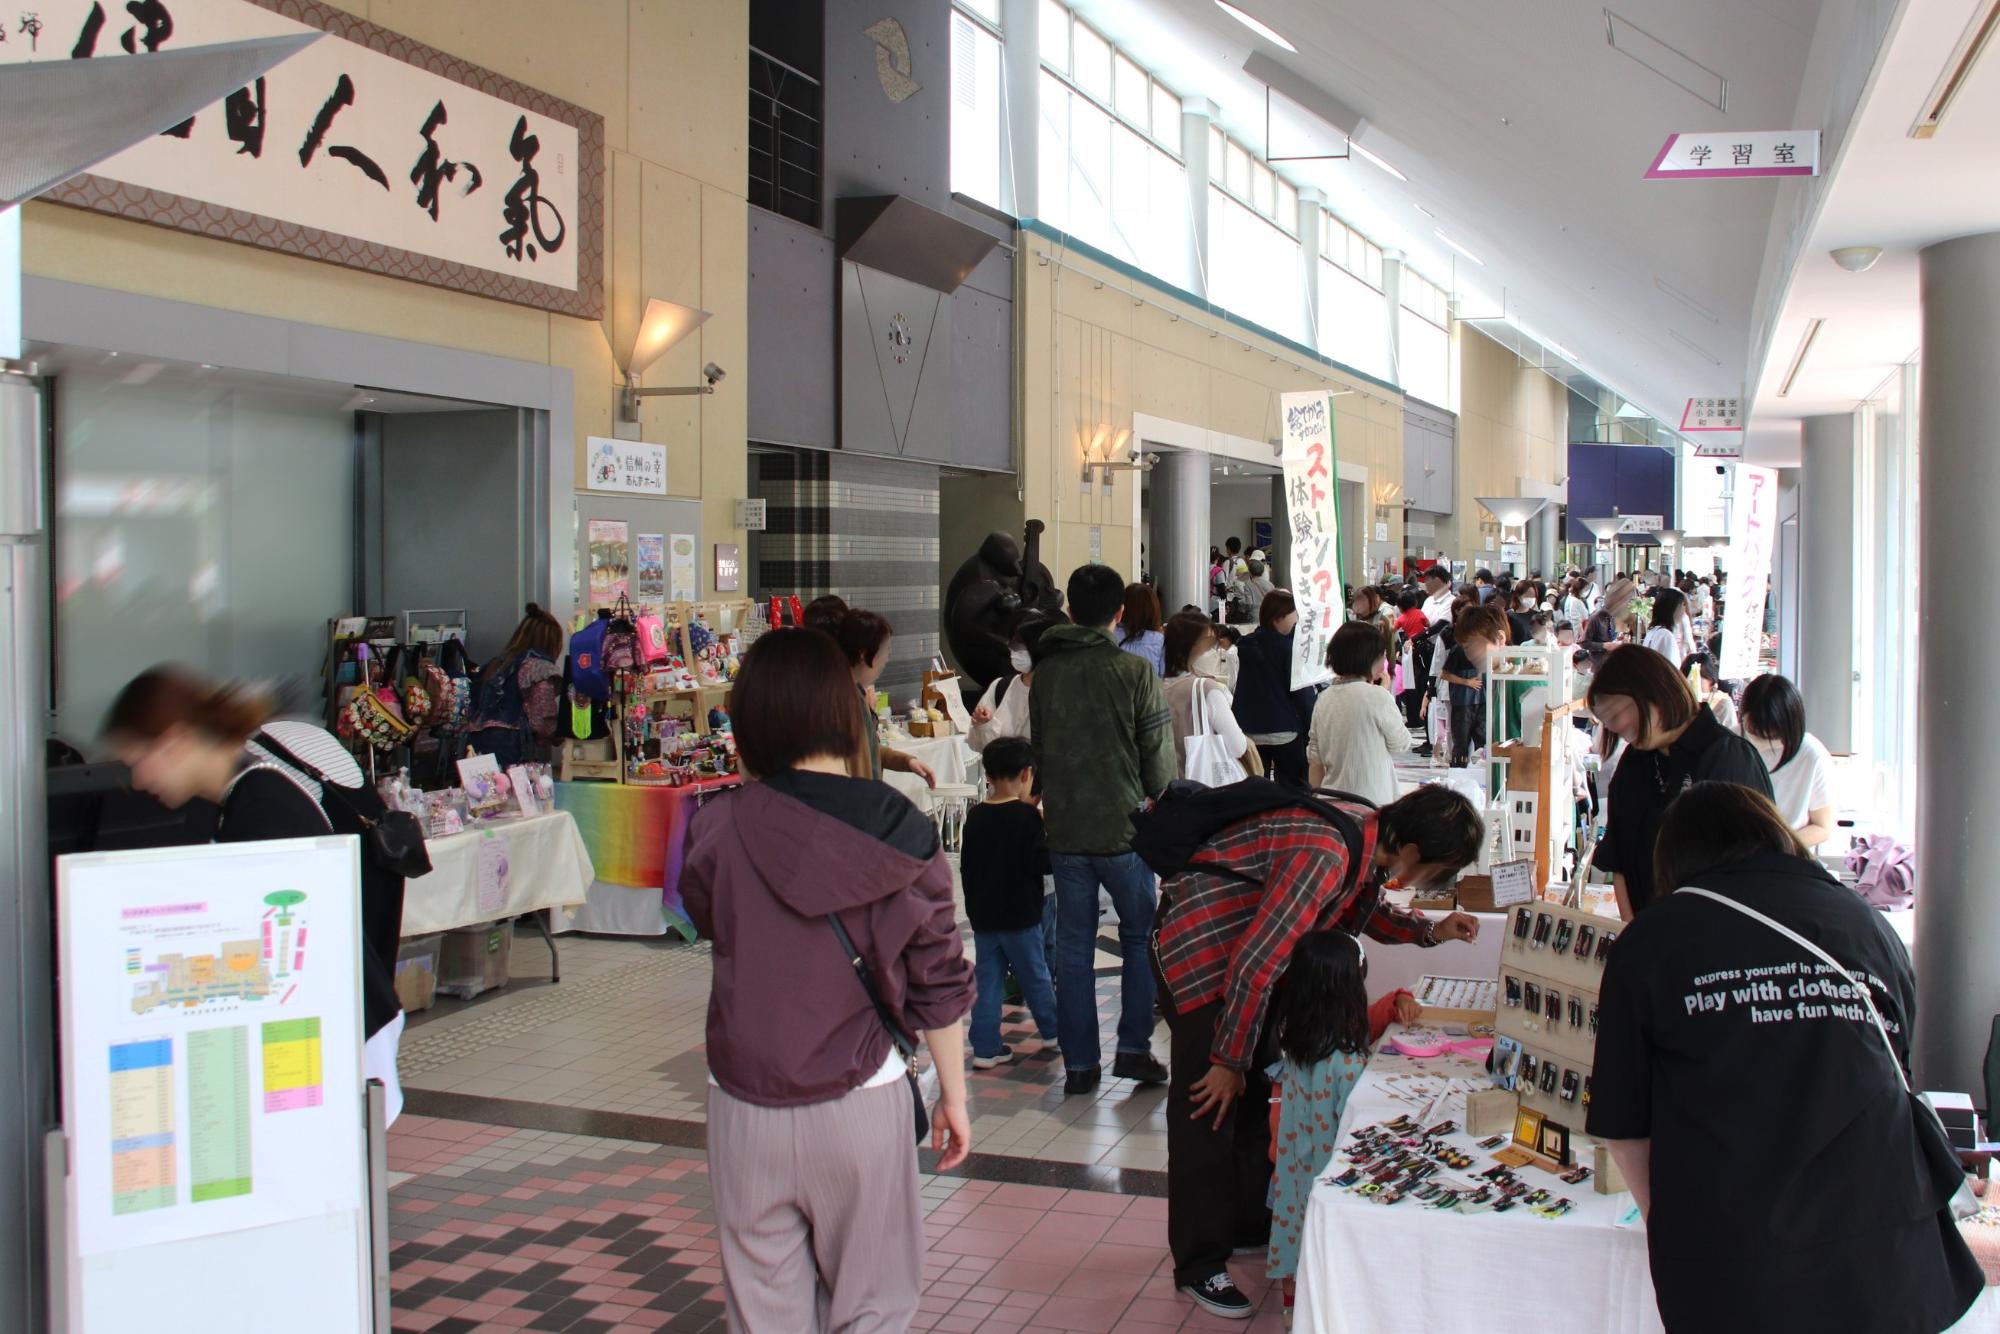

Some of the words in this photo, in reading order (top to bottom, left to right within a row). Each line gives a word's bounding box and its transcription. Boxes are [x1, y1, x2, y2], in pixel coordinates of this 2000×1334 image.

[1689, 142, 1796, 166] 学習室
[1693, 969, 1741, 986] express
[1744, 962, 1797, 981] yourself
[1799, 962, 1811, 975] in
[1684, 991, 1726, 1016] Play
[1732, 980, 1782, 1004] with
[1751, 1006, 1793, 1023] have
[1797, 1002, 1827, 1019] fun
[1831, 1003, 1864, 1021] with
